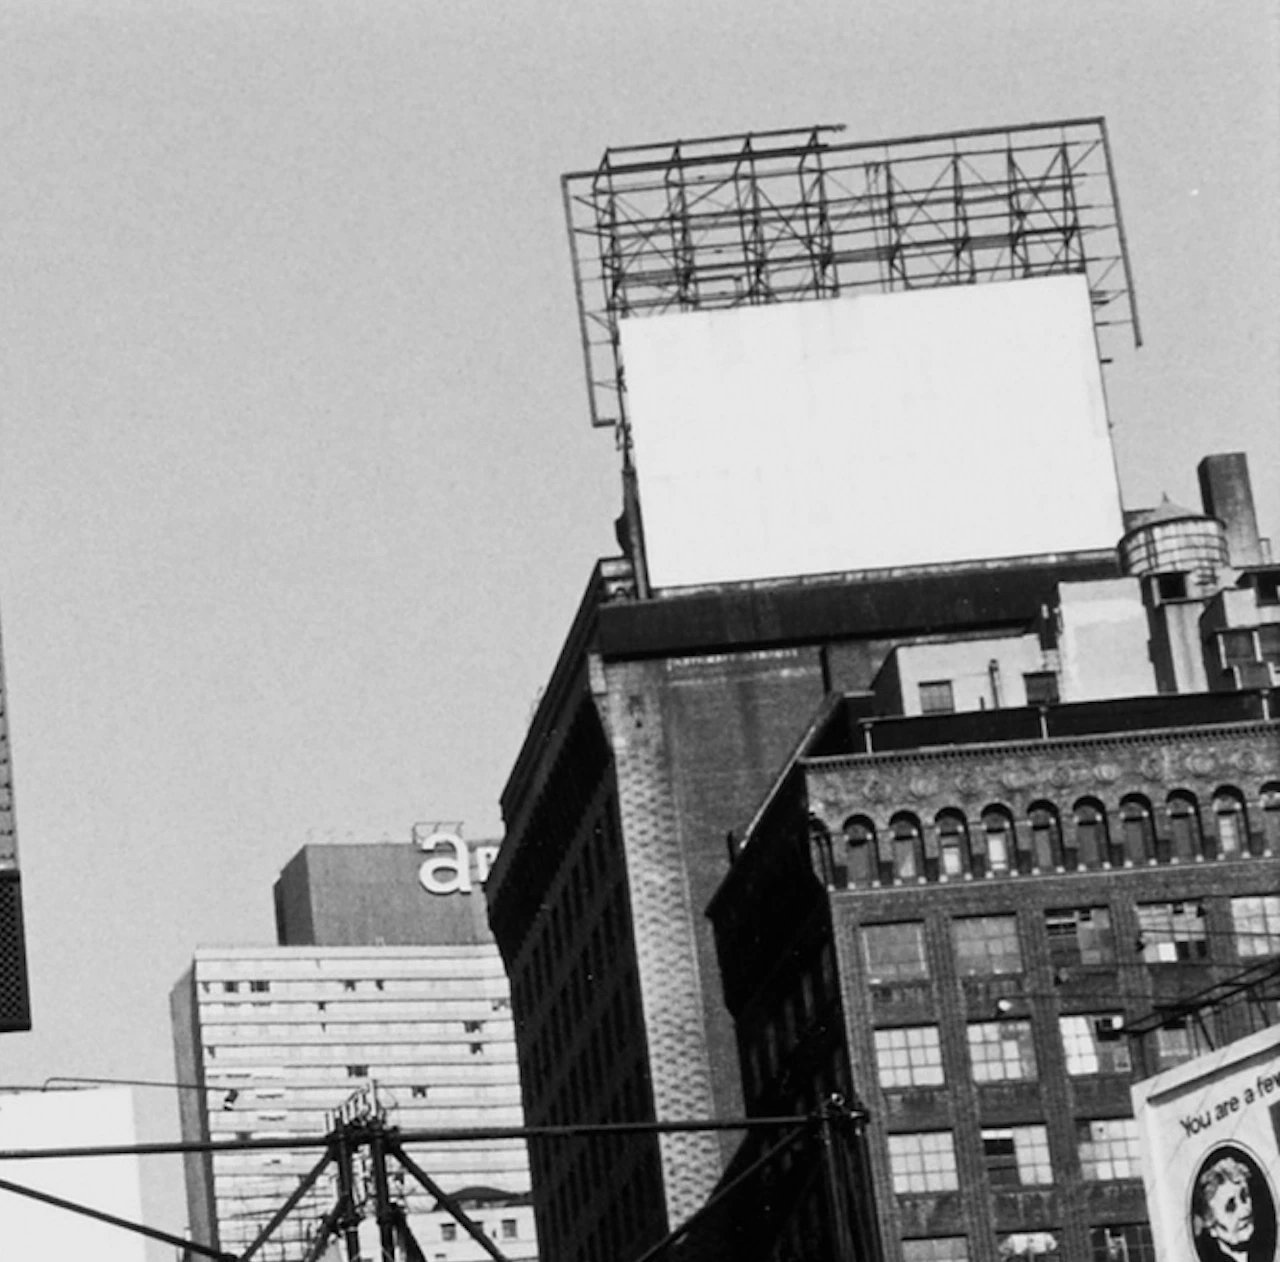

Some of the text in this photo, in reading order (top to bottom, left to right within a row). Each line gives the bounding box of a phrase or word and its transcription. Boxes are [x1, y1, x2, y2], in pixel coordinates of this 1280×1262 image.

[1179, 1109, 1212, 1138] You
[1215, 1095, 1240, 1122] are
[1244, 1087, 1256, 1105] a
